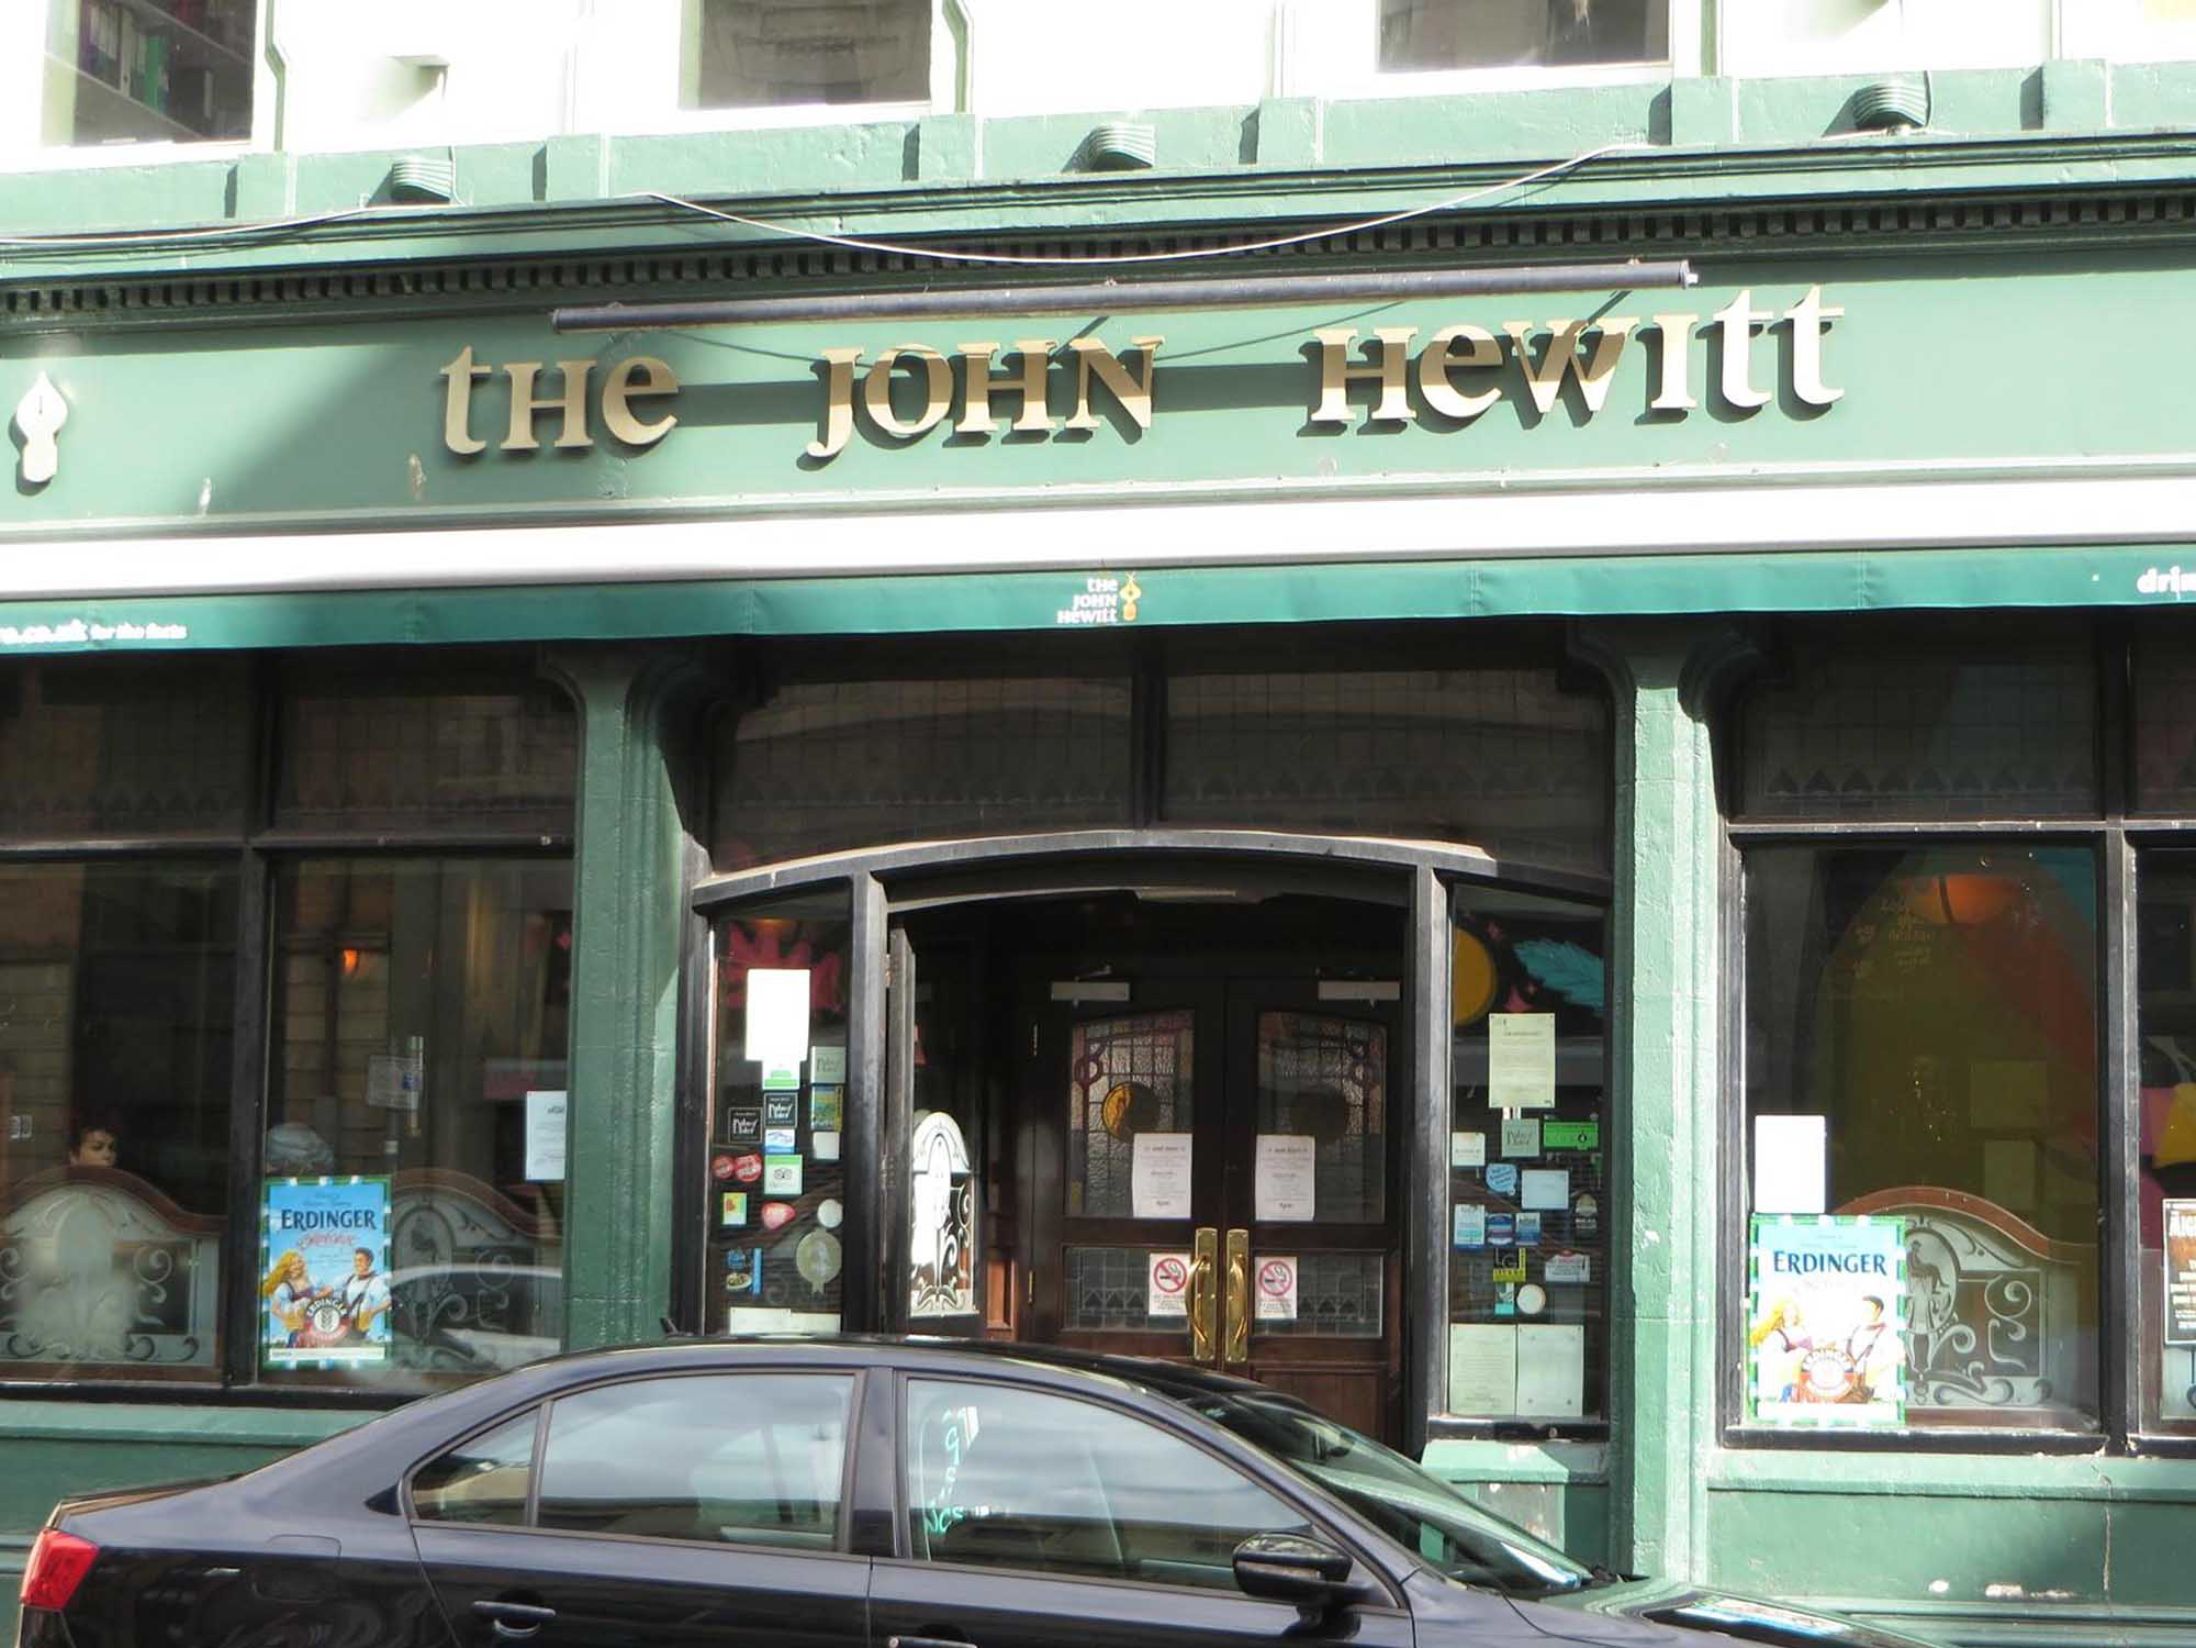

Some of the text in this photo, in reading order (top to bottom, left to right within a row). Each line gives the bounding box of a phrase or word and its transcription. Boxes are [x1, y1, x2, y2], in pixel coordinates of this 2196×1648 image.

[805, 336, 1165, 457] JOHN
[1072, 594, 1118, 611] JOHN
[281, 1209, 376, 1231] ERDINGER
[1773, 1250, 1887, 1276] ERDINGER
